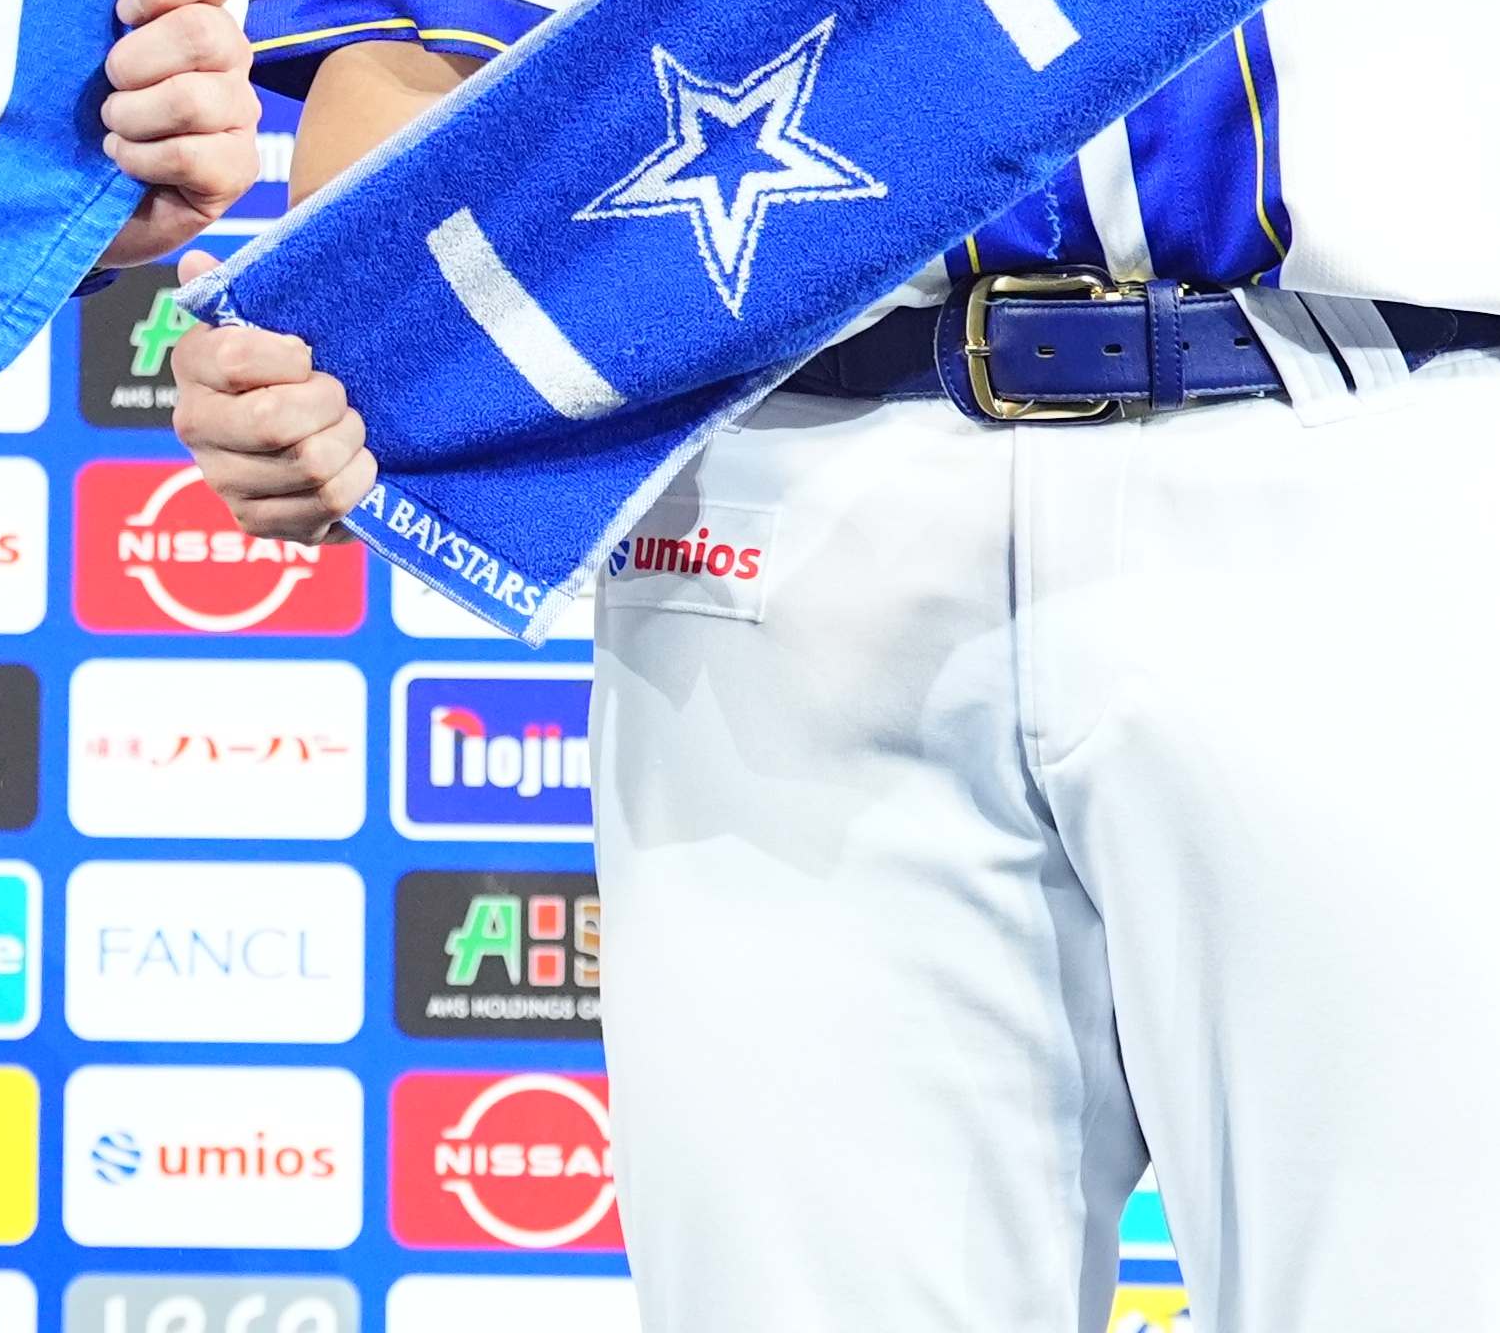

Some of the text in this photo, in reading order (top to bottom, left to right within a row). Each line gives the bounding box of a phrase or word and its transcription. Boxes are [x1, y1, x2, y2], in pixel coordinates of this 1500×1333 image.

[426, 208, 628, 419] I
[386, 498, 542, 618] BAYSTARS
[634, 528, 762, 580] umios
[97, 926, 330, 979] FANCL
[159, 1132, 335, 1177] umios
